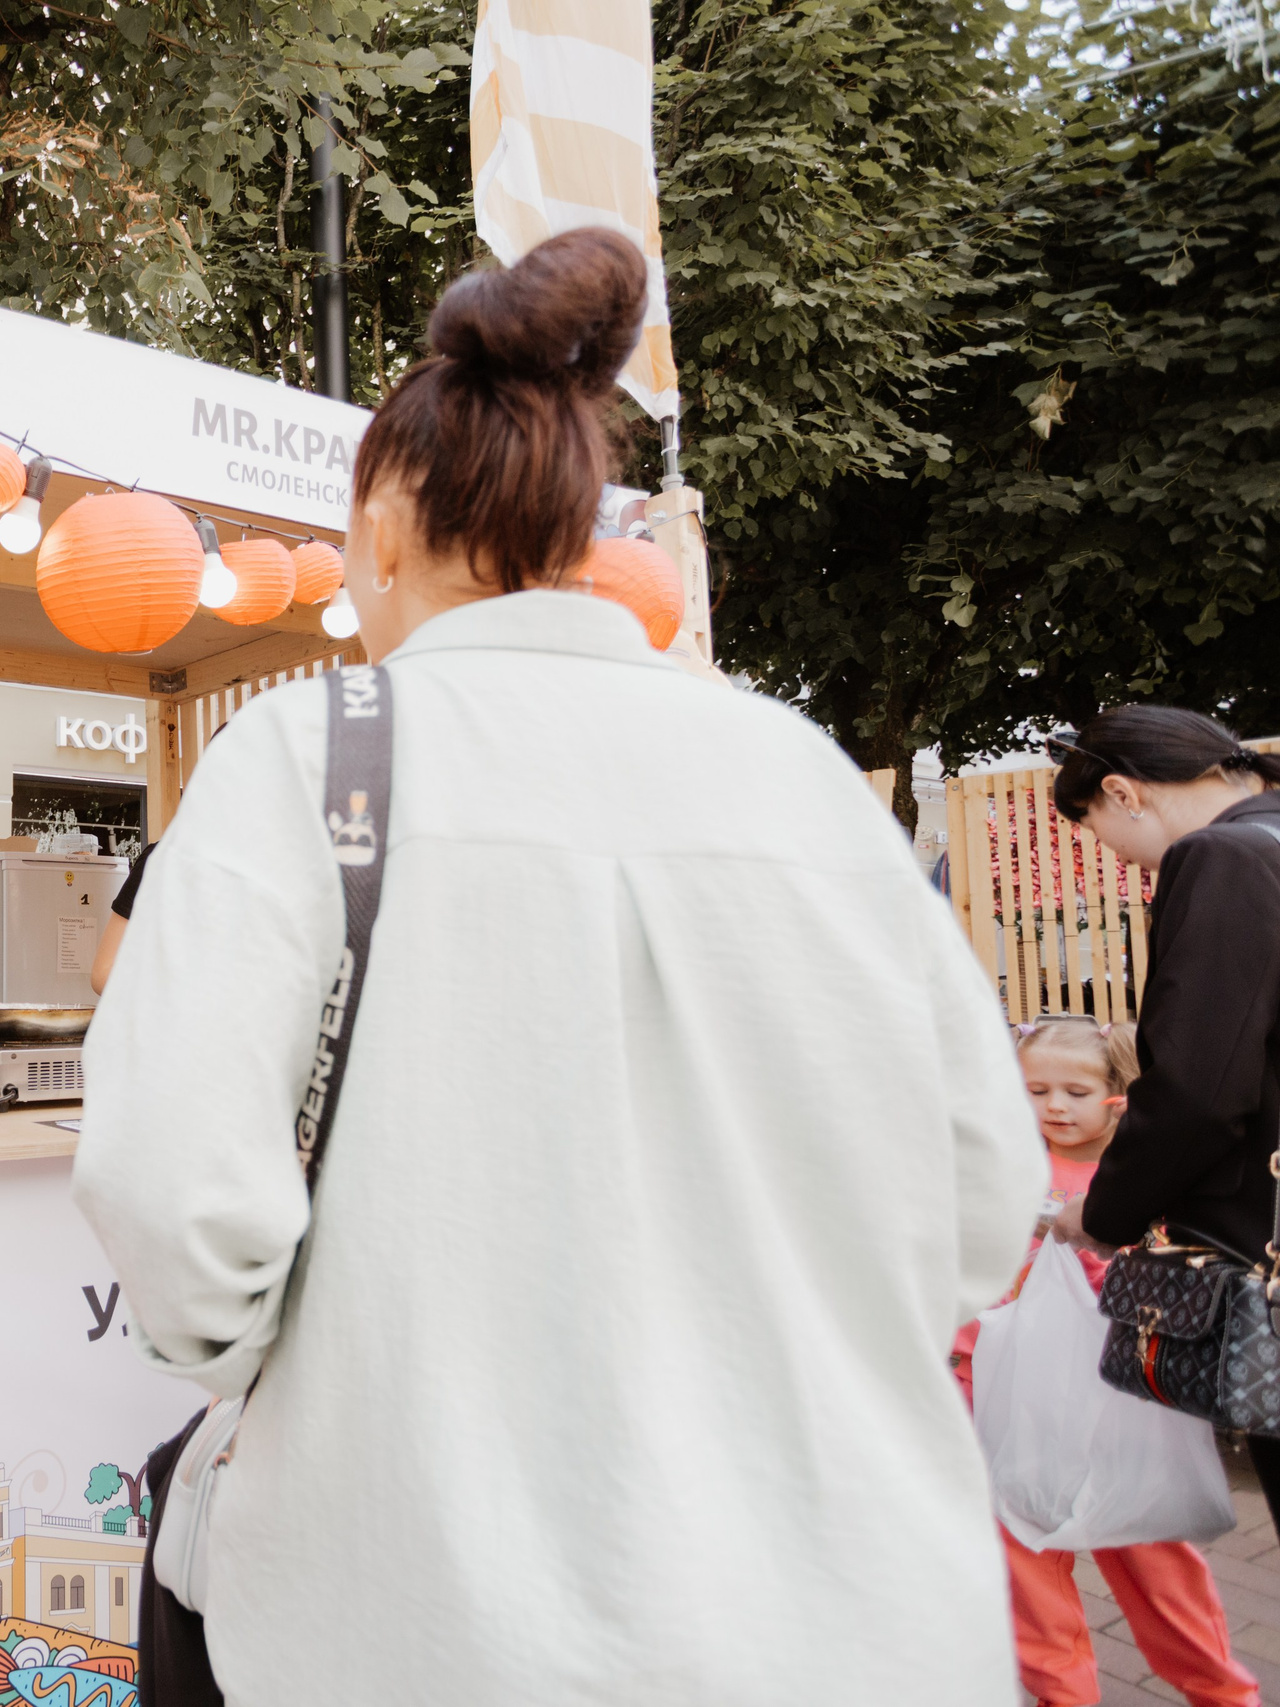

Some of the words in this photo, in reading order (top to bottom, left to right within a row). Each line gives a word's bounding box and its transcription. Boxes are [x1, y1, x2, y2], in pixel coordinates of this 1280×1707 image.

[192, 397, 361, 475] MR.КРА
[226, 460, 349, 508] СМОЛЕНСК
[80, 893, 90, 905] 1
